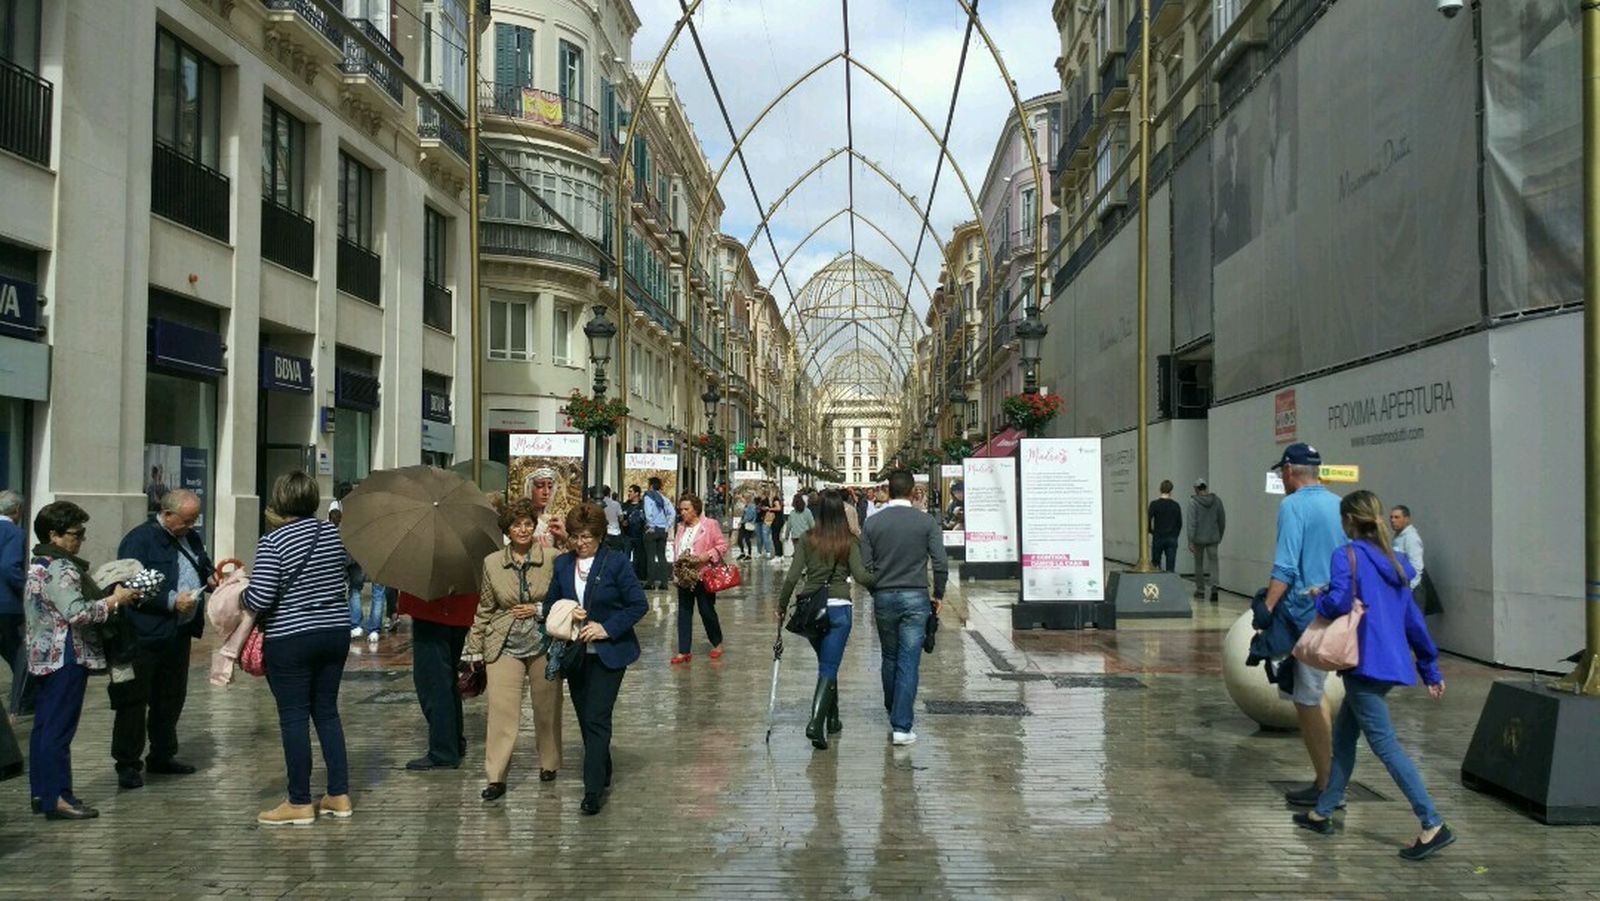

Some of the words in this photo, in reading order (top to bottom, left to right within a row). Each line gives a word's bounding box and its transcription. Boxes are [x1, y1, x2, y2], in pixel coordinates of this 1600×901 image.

[274, 355, 302, 383] BBVA
[1328, 396, 1377, 430] PROXIMA
[1379, 381, 1455, 421] APERTURA
[1351, 428, 1424, 447] www.massimodutti.com
[1331, 469, 1355, 477] ONCE
